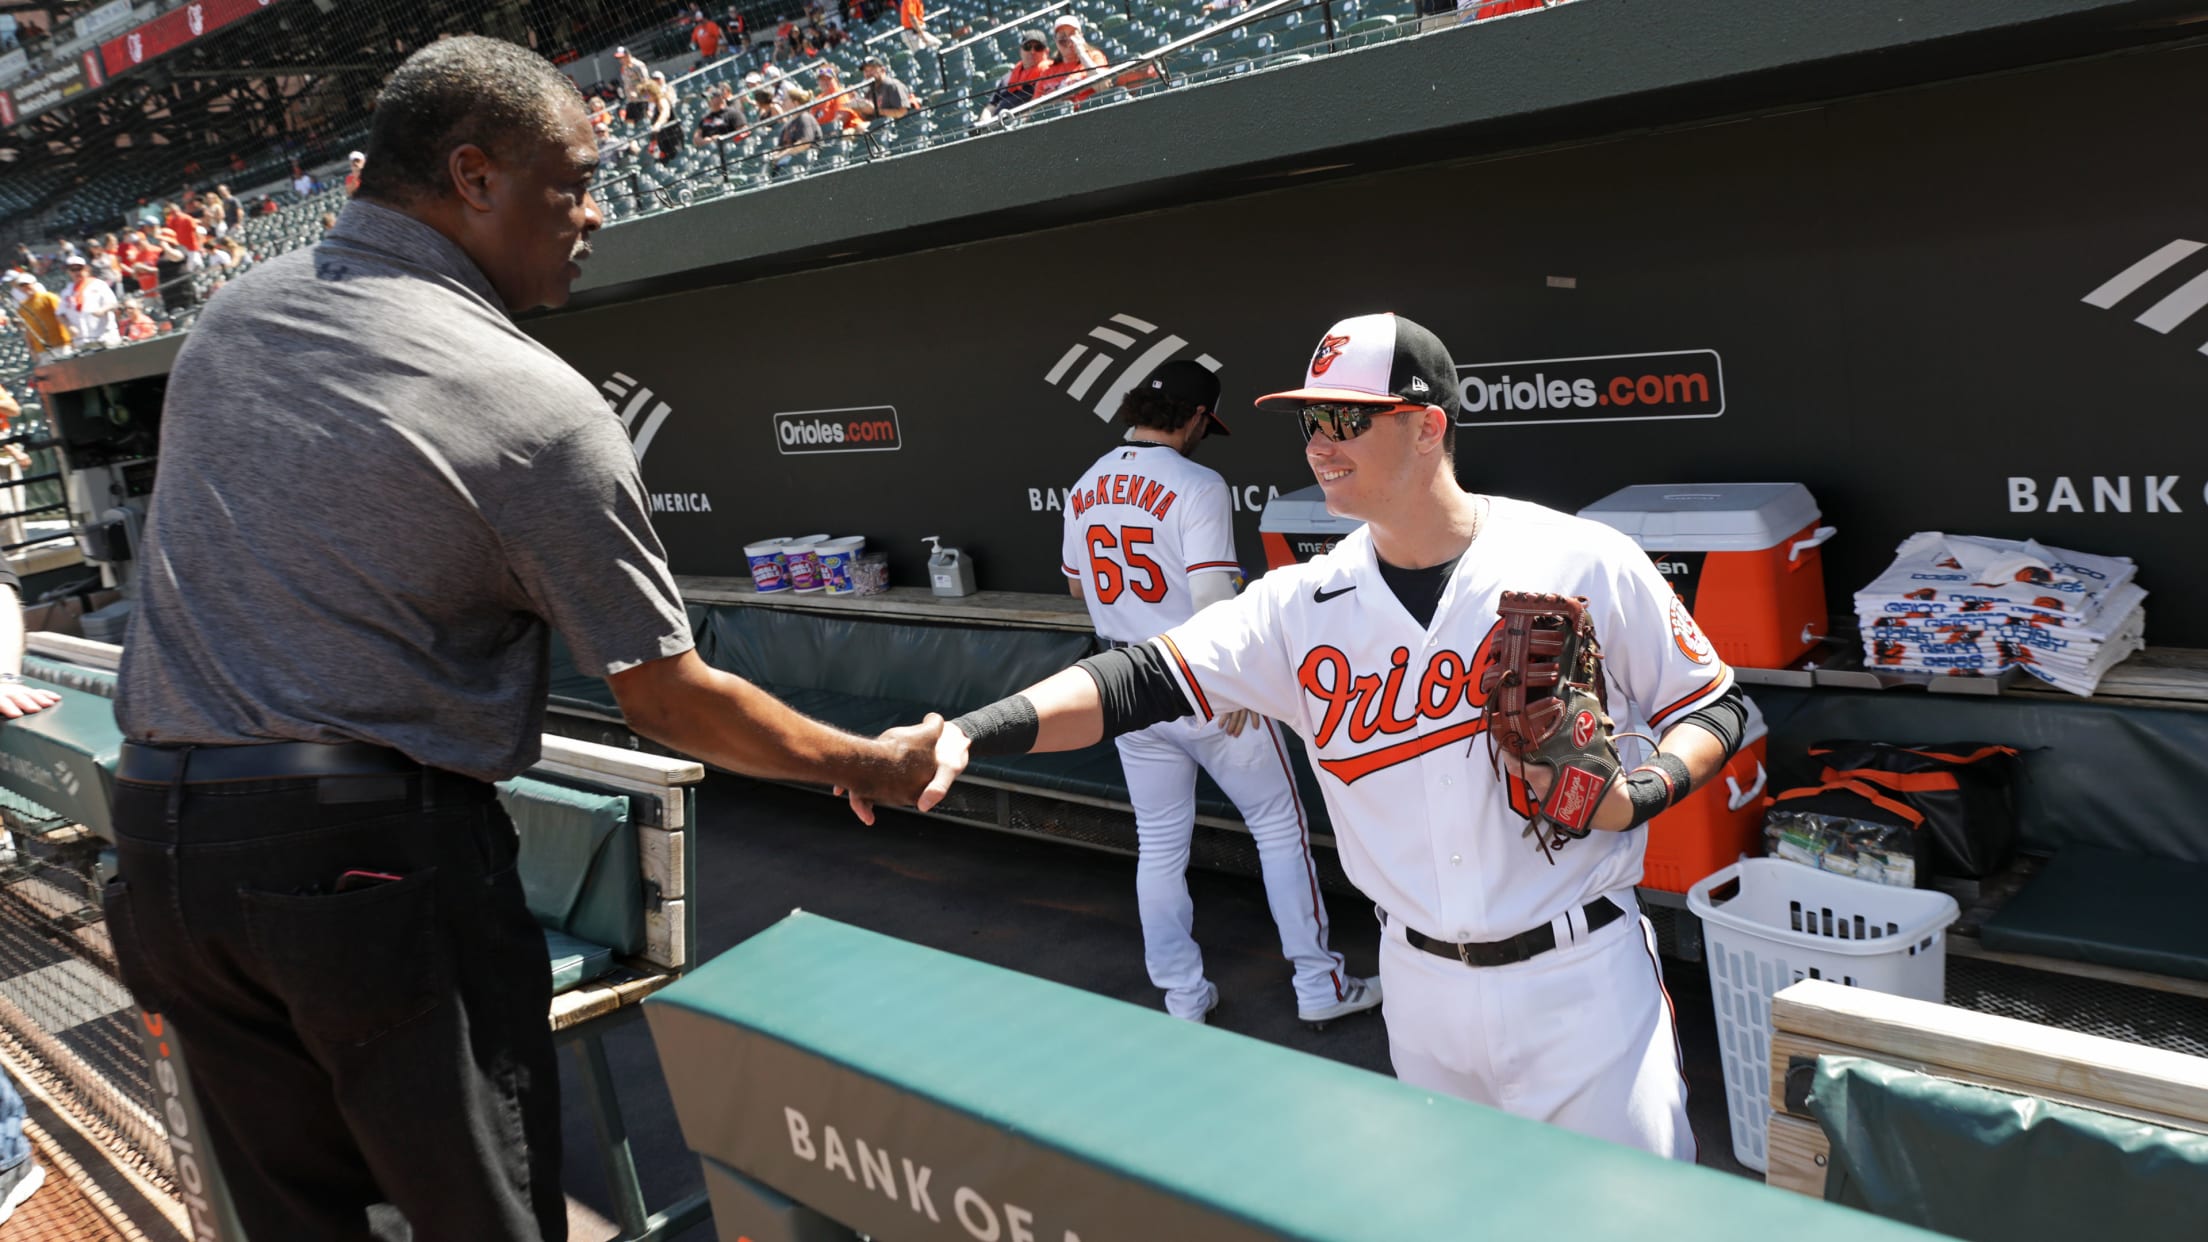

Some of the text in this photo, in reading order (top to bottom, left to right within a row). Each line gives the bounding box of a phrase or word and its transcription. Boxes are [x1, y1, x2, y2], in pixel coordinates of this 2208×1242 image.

[1459, 372, 1709, 413] Orioles.com
[780, 420, 894, 445] Orioles.com
[651, 493, 712, 512] MERICA
[2008, 475, 2183, 513] BANK
[1086, 525, 1168, 605] 65
[1298, 617, 1507, 749] Oriol
[784, 1106, 940, 1223] BANK
